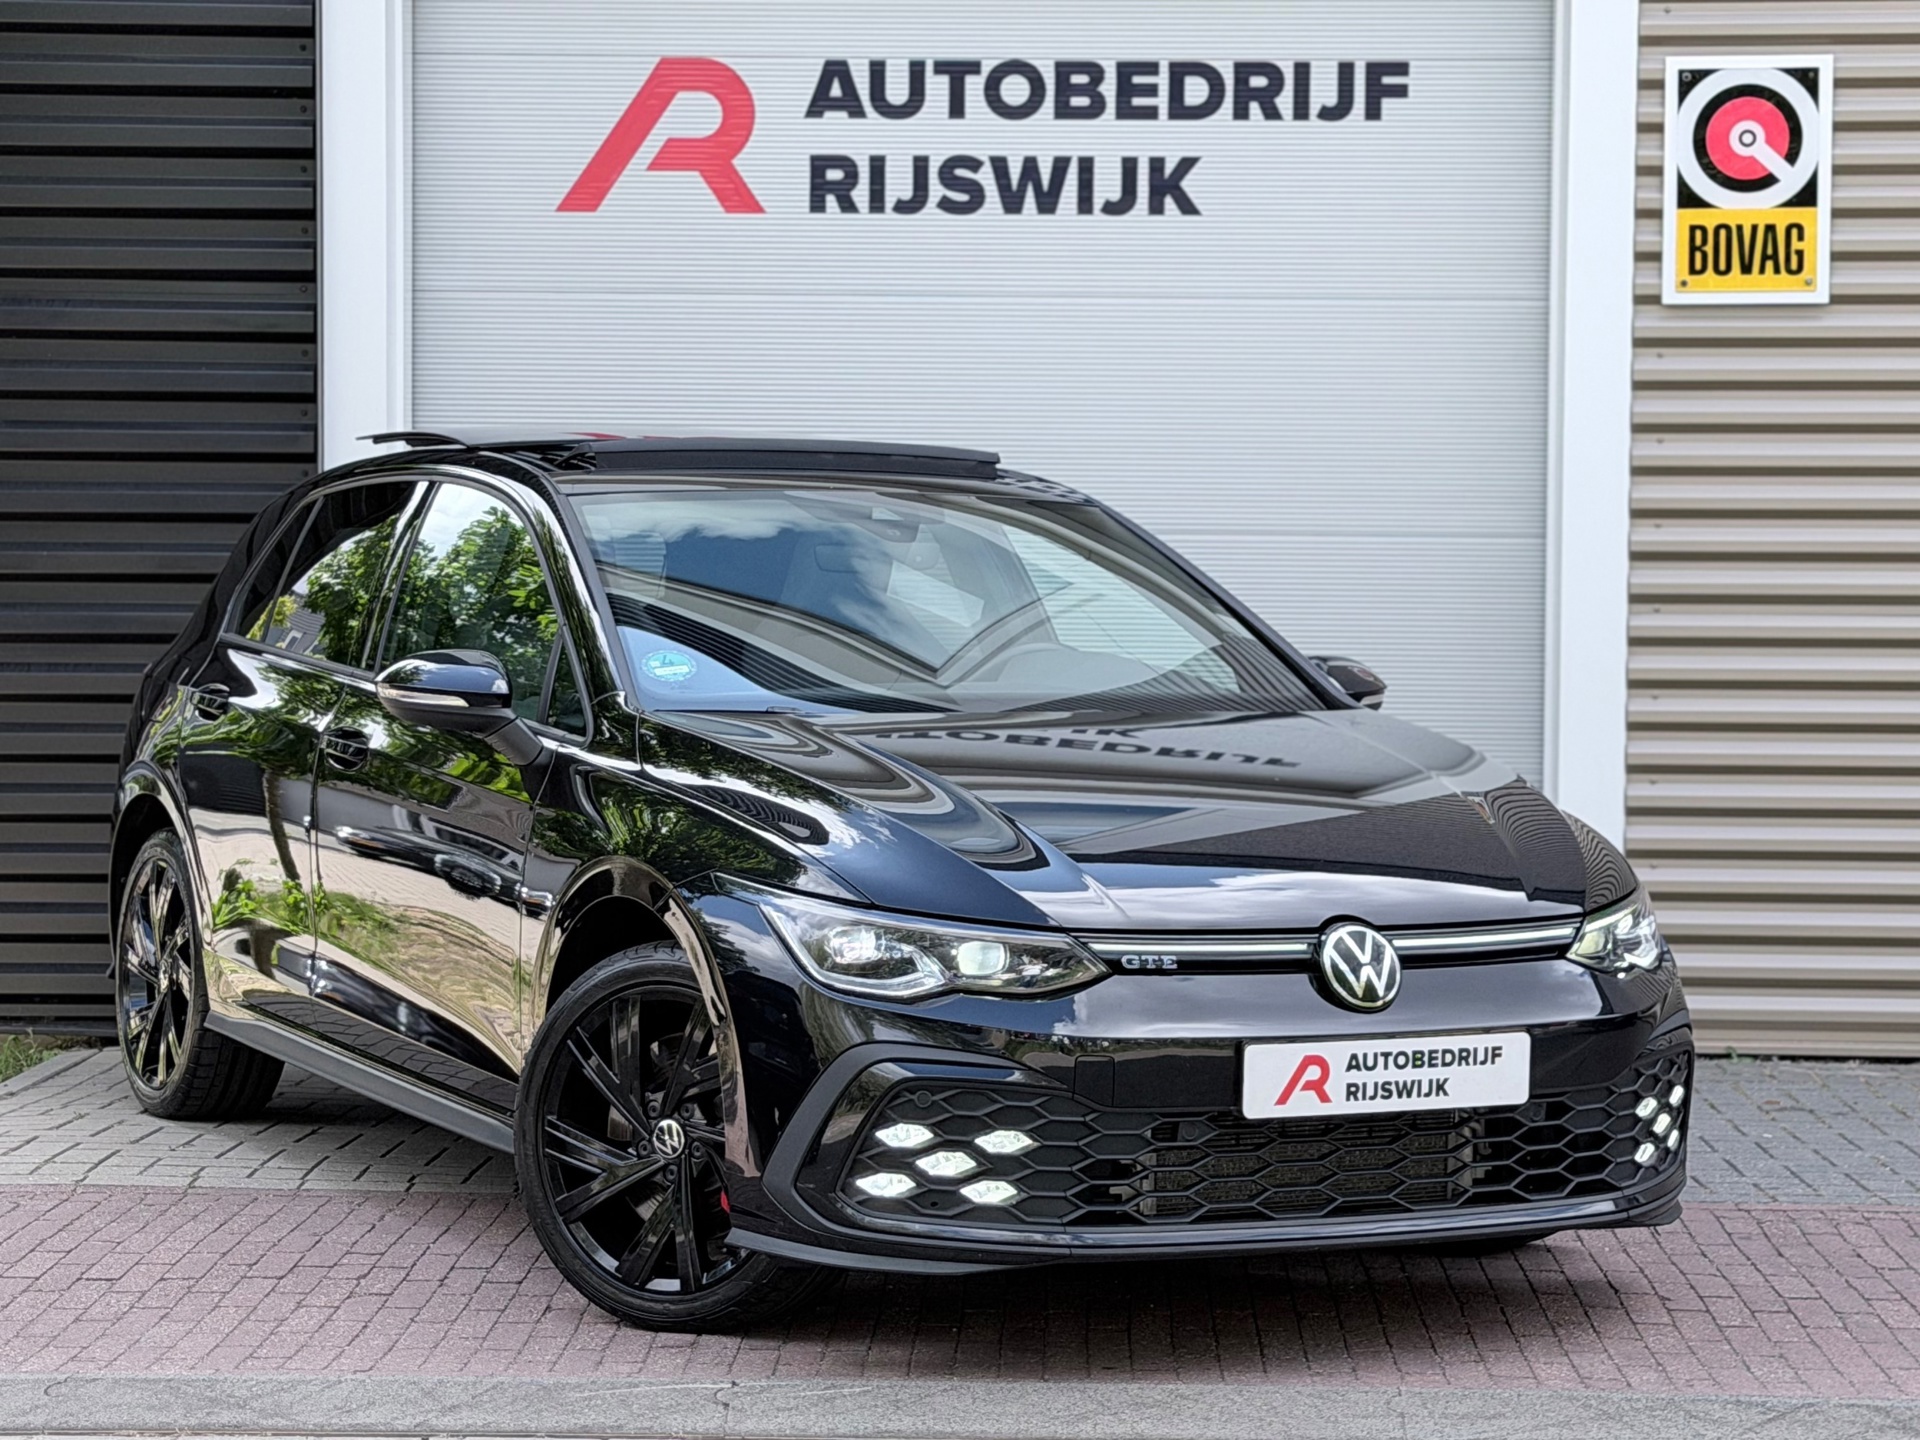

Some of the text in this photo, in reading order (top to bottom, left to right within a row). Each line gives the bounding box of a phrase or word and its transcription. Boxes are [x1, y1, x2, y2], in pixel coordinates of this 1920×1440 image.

[805, 59, 1410, 121] AUTOBEDRIJF
[808, 154, 1202, 215] RIJSWIJK
[1688, 222, 1805, 276] BOVAG
[1121, 955, 1178, 970] GTE
[1345, 1046, 1503, 1073] AUTOBEDRIJF
[1345, 1077, 1450, 1102] RIJSWIJK
